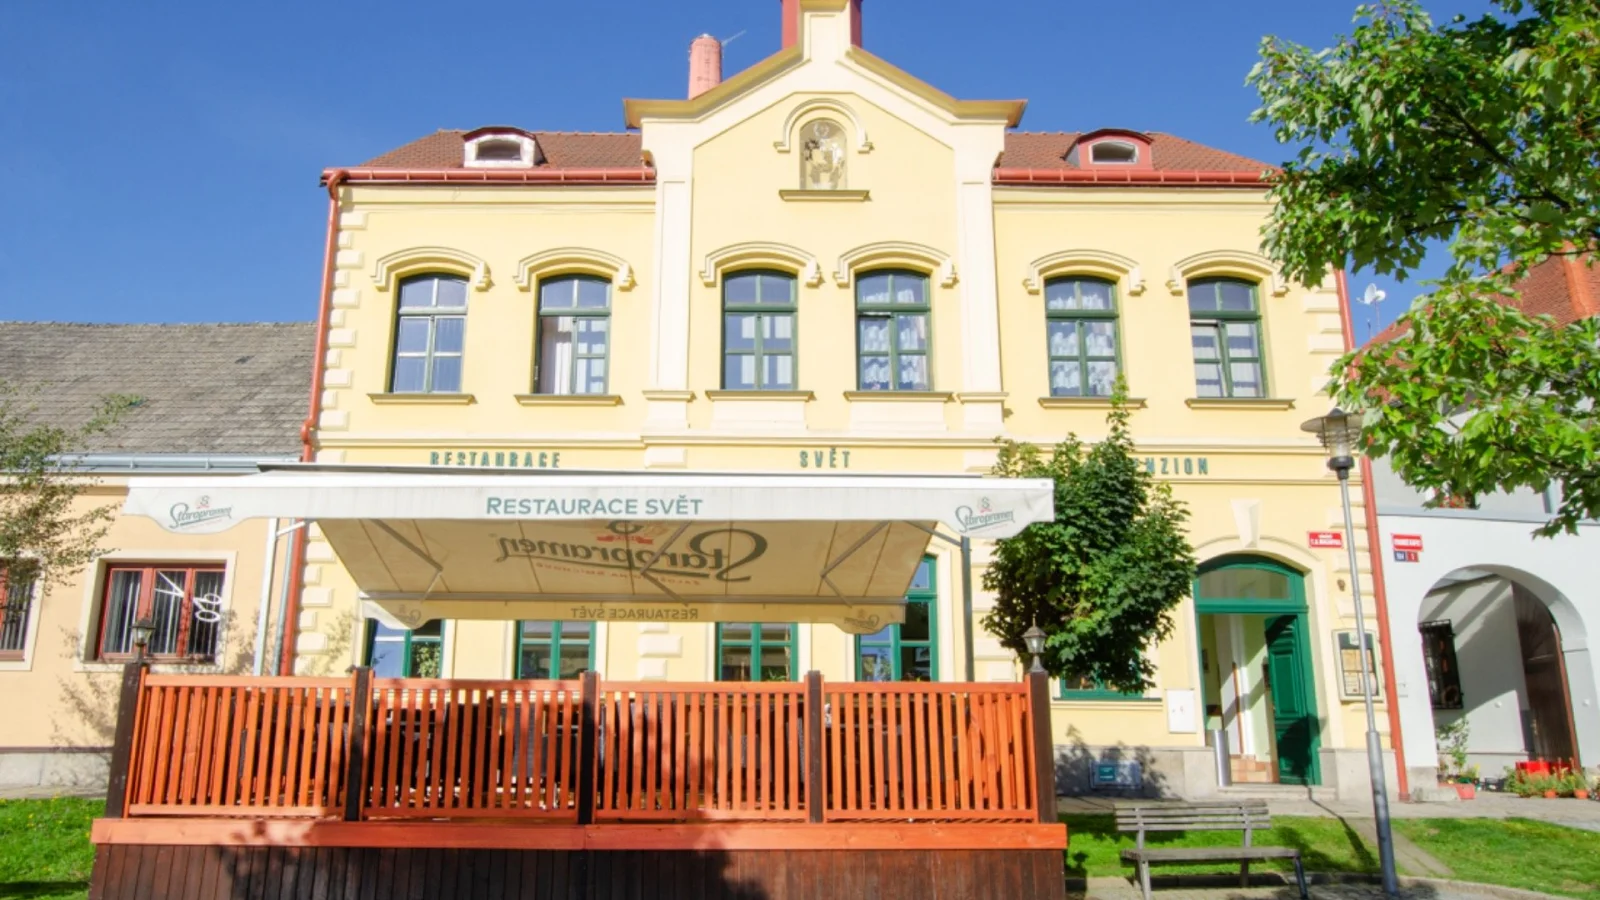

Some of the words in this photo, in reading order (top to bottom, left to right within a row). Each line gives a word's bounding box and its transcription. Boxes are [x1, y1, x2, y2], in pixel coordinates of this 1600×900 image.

[430, 451, 560, 468] RESTAURACE
[800, 446, 850, 468] SVĚT
[1131, 457, 1208, 475] NZION
[486, 497, 638, 515] RESTAURACE
[645, 495, 703, 515] SVĚT
